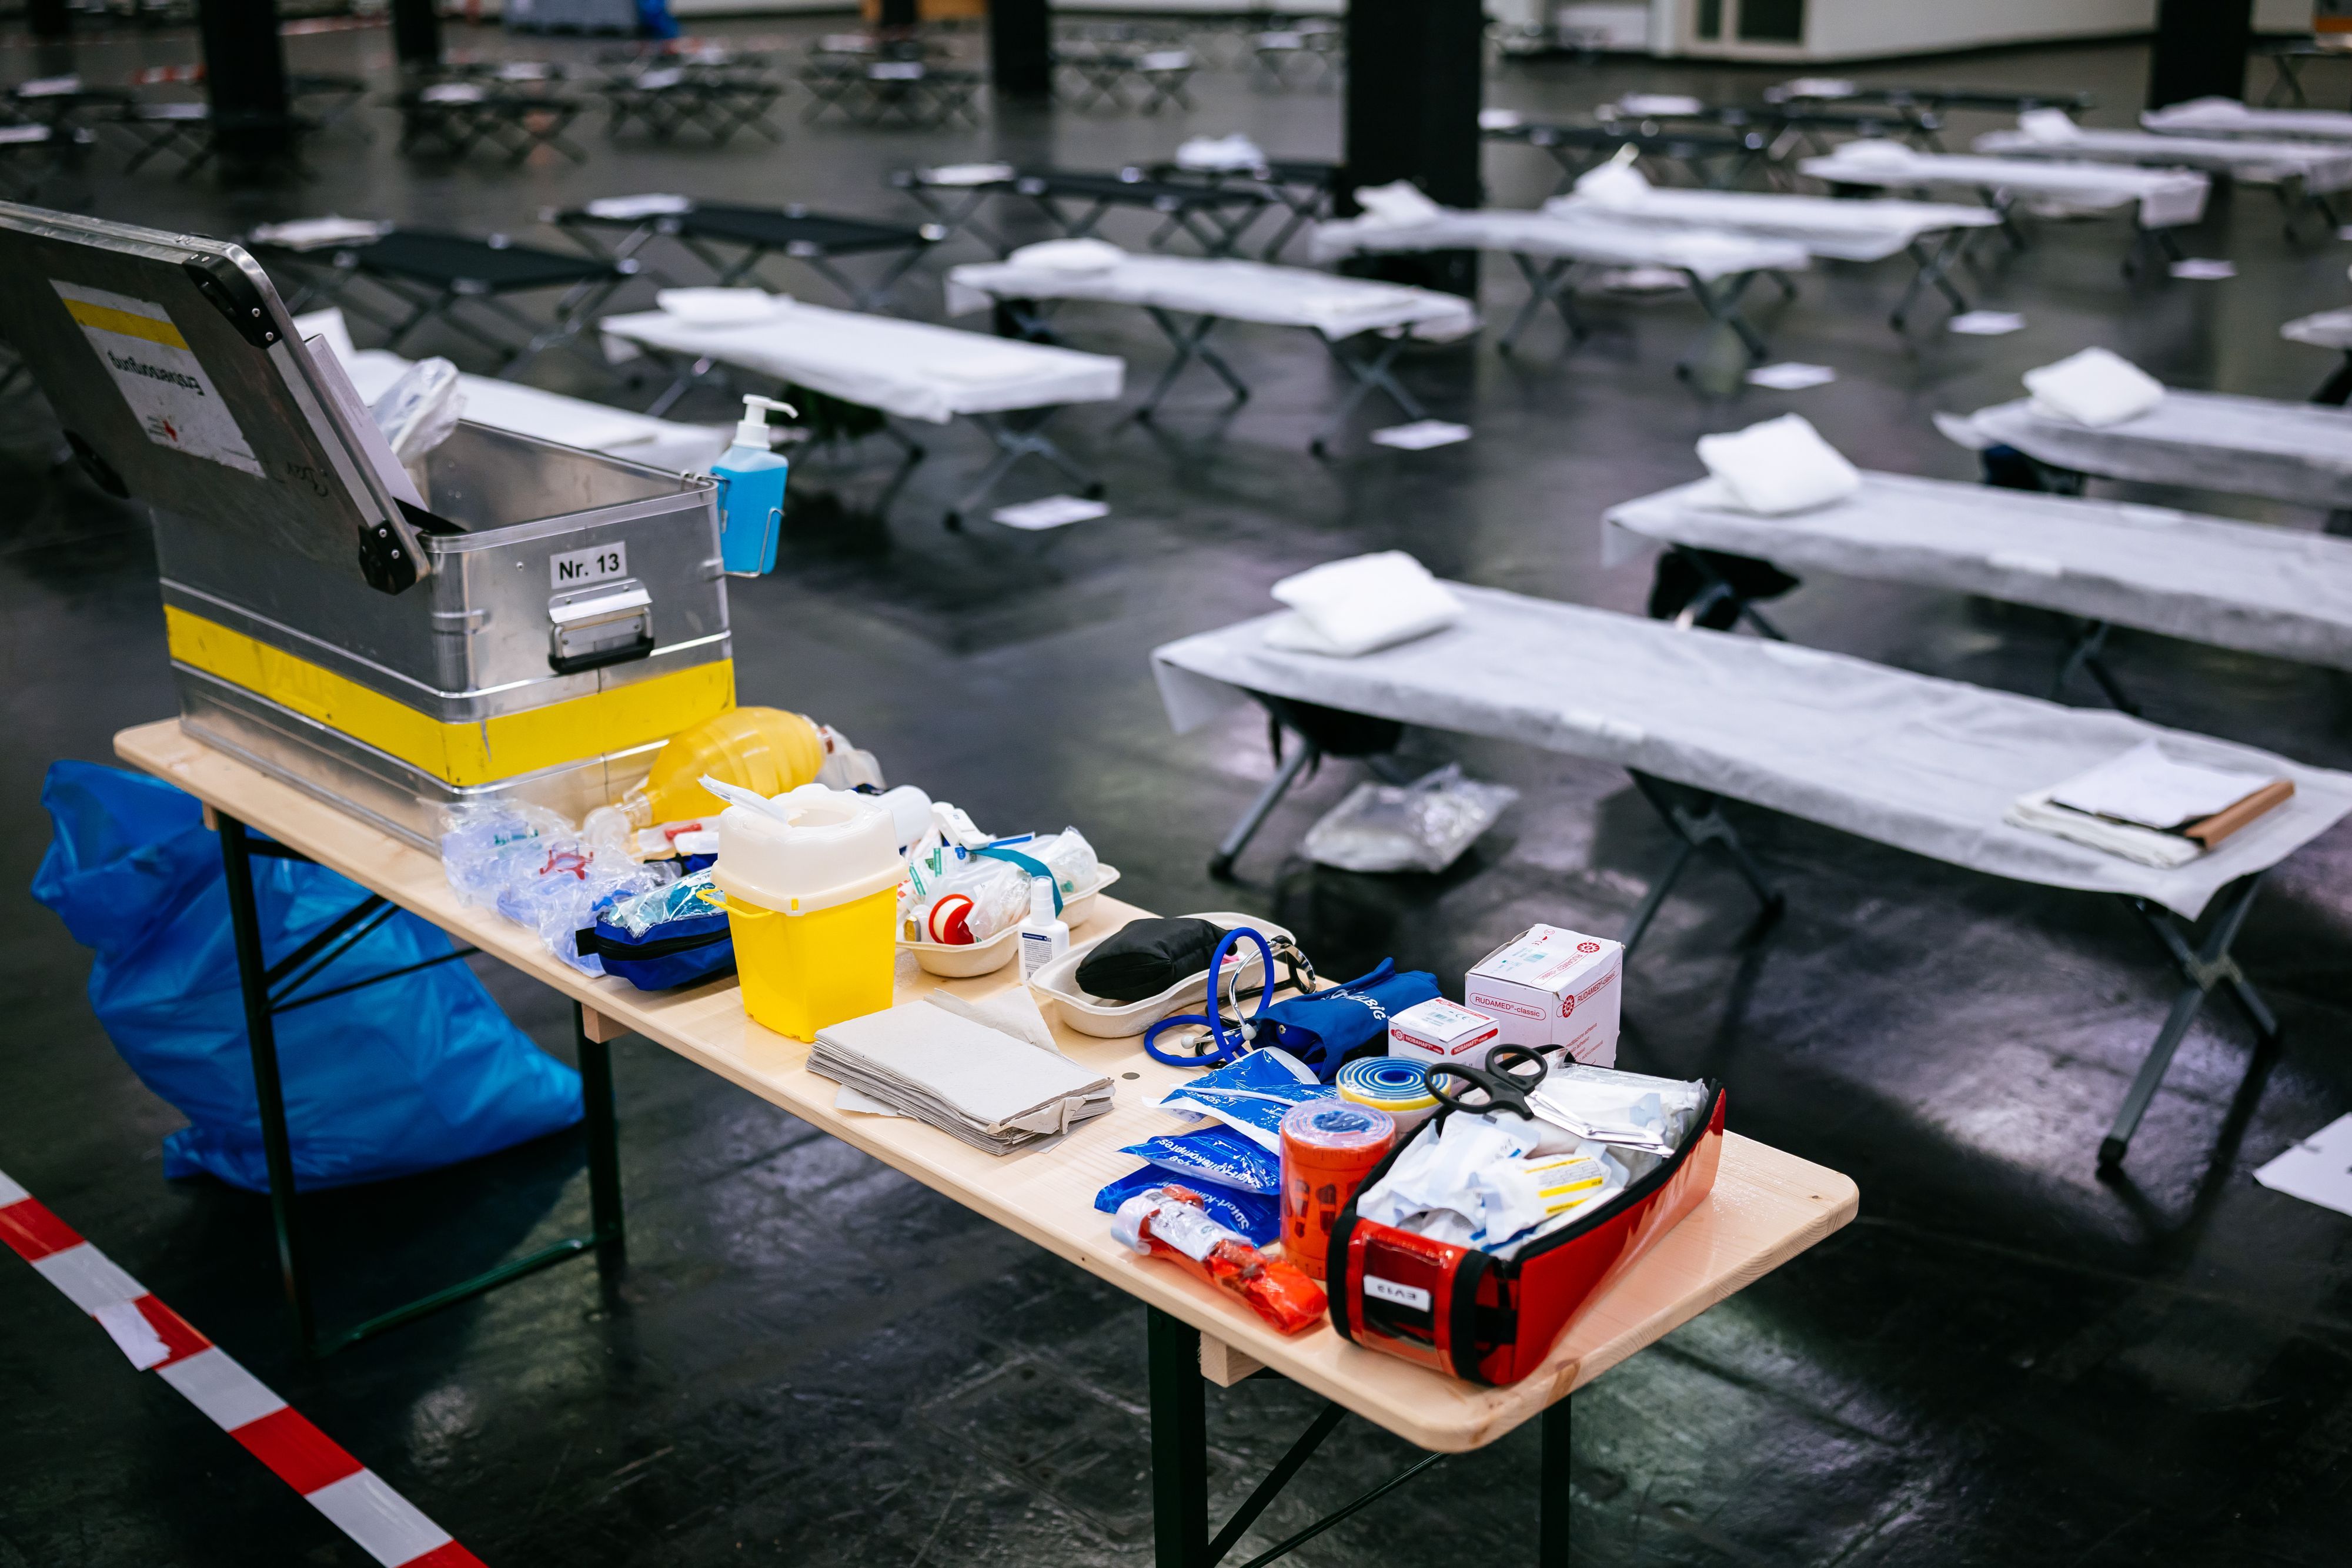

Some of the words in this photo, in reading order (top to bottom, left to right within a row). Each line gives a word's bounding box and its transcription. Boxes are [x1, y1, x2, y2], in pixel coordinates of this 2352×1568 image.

[559, 560, 589, 581] Nr.
[597, 553, 619, 573] 13
[1378, 1285, 1416, 1301] EV13
